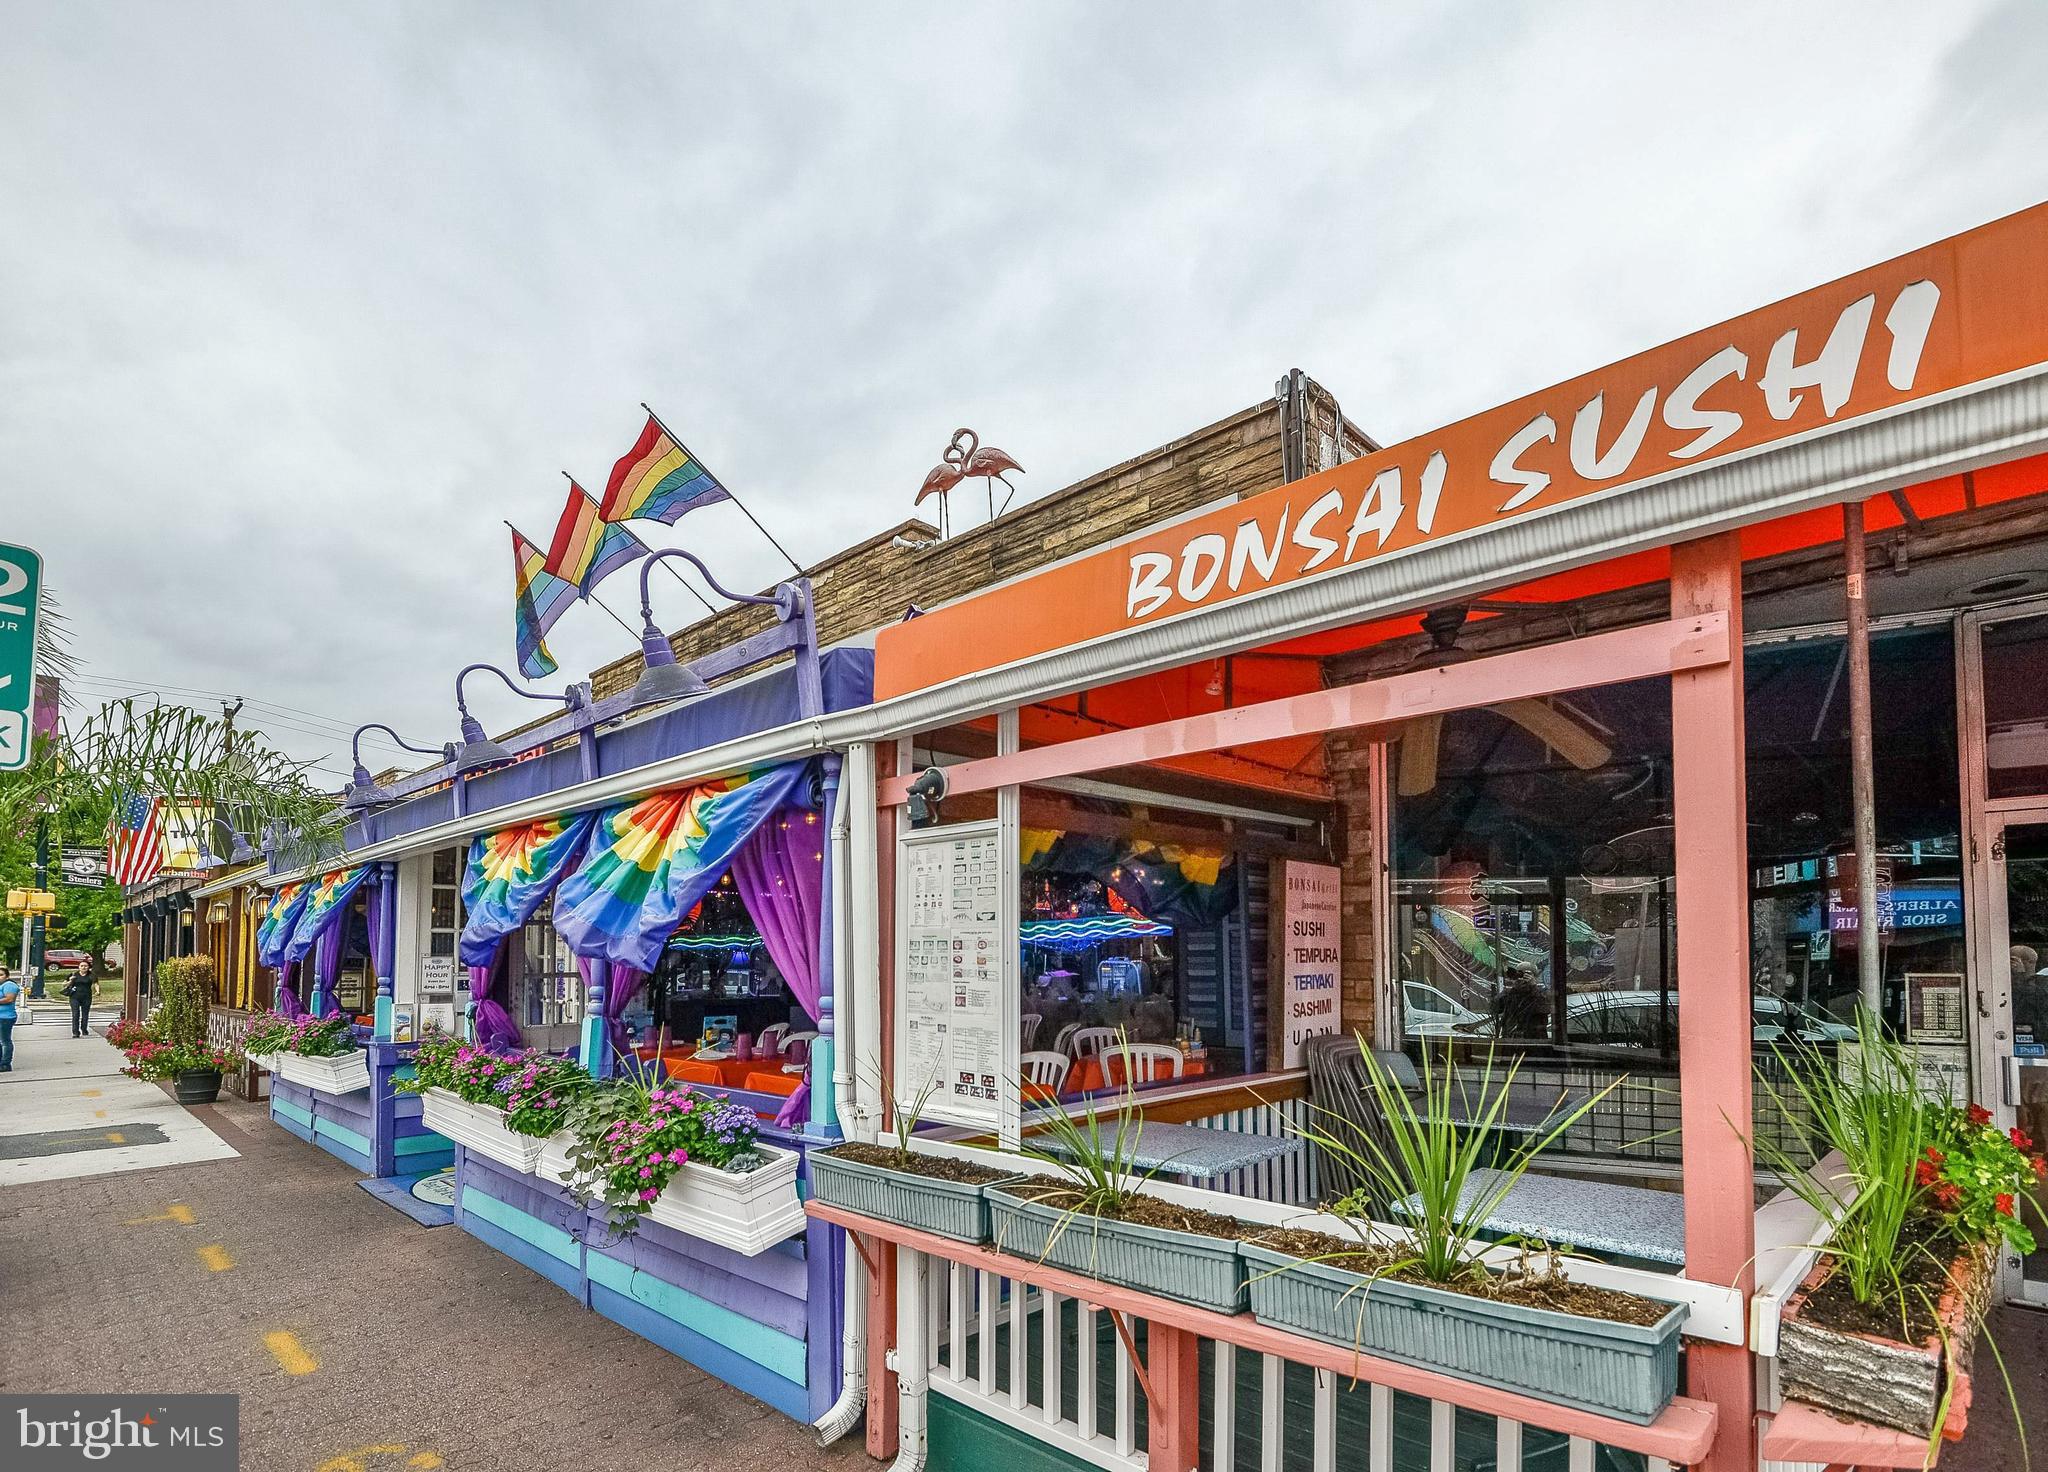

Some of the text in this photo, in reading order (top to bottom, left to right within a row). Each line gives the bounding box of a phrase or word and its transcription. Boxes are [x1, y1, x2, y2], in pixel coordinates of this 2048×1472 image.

[1125, 278, 1942, 619] BONSAI SUSHI
[68, 874, 102, 886] Steelers
[1288, 877, 1321, 892] BONSAI
[1293, 920, 1325, 937] SUSHI
[1293, 947, 1339, 963] TEMPURA
[1293, 973, 1334, 991] TERIYAKI
[1293, 998, 1332, 1018] SASHIMI
